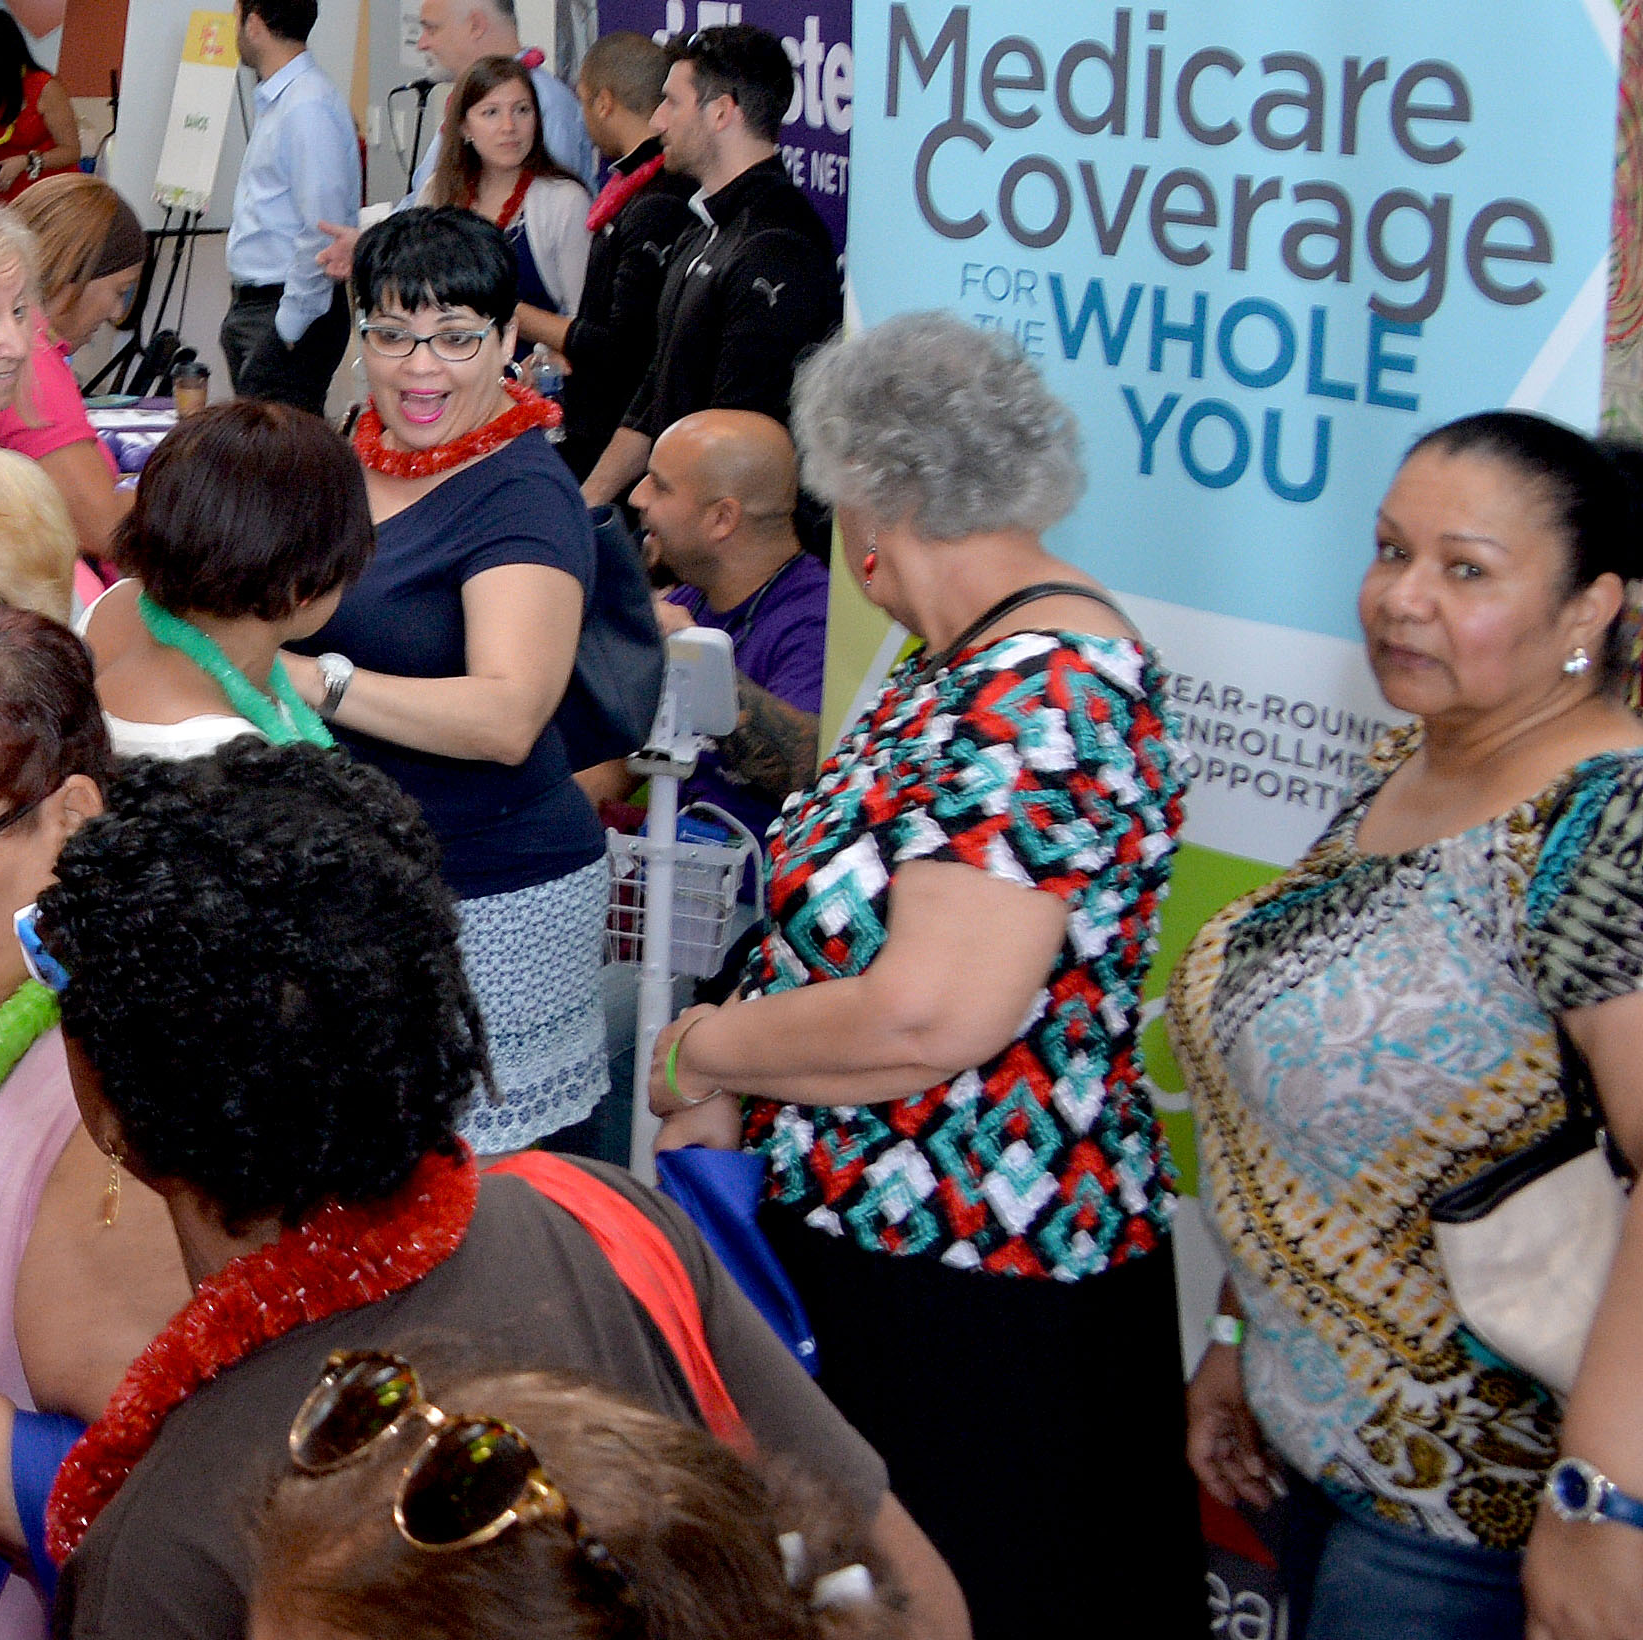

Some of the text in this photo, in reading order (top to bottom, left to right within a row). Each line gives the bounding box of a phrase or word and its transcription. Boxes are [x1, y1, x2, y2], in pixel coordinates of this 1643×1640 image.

[884, 1, 1473, 165] Medicare
[914, 116, 1555, 323] Coverage
[960, 262, 1038, 305] FOR
[1048, 271, 1424, 412] WHOLE
[1120, 384, 1334, 503] YOU
[1181, 751, 1347, 810] OPPORT
